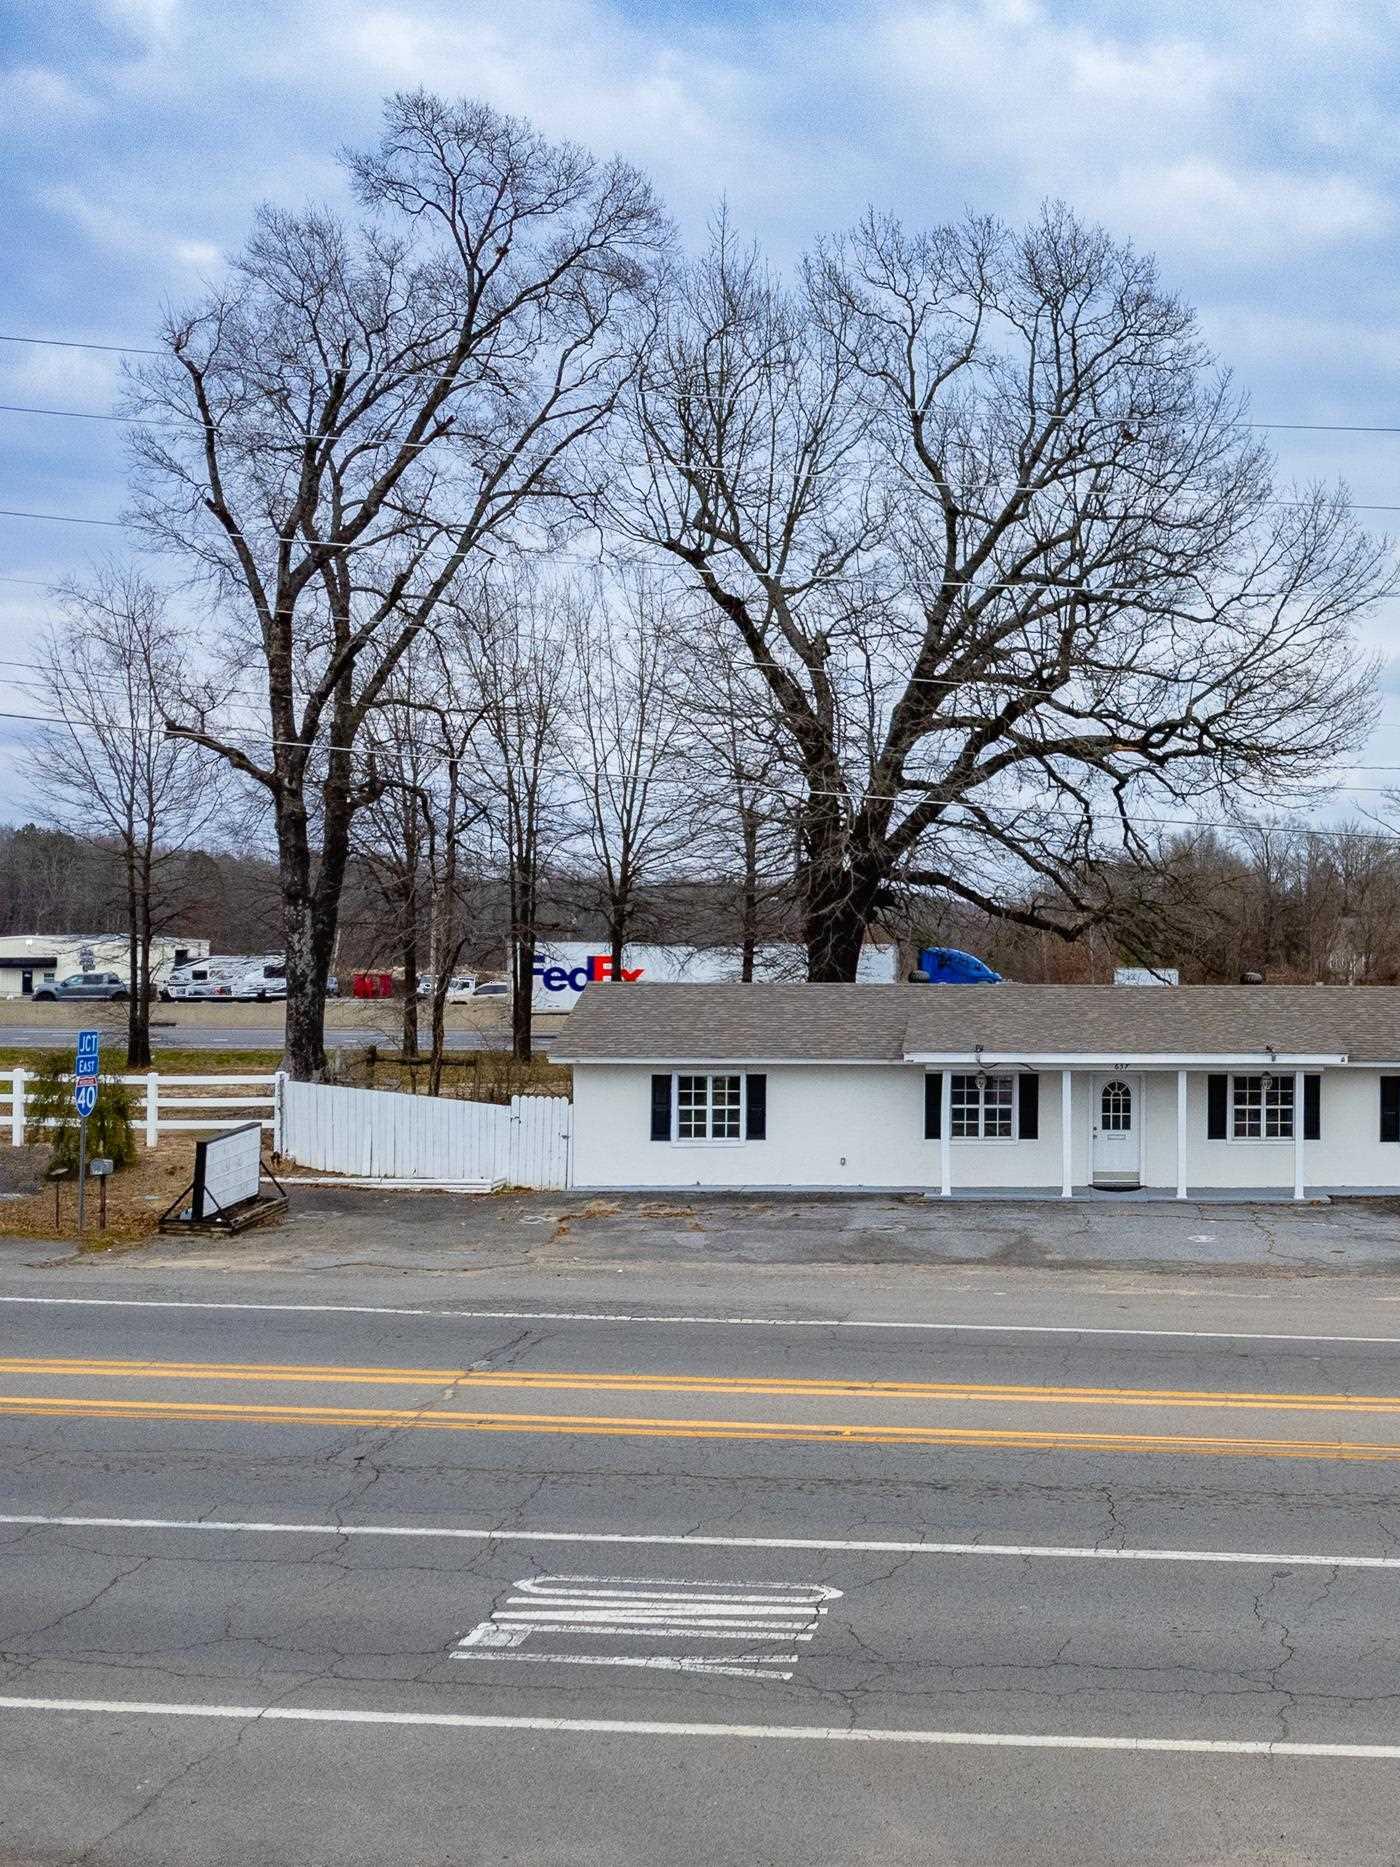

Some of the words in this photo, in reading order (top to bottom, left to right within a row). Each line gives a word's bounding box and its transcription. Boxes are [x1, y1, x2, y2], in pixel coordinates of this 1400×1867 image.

[79, 1034, 97, 1052] JCT
[79, 1060, 95, 1073] EAST
[77, 1086, 96, 1109] 40
[448, 1575, 844, 1680] ONLY
